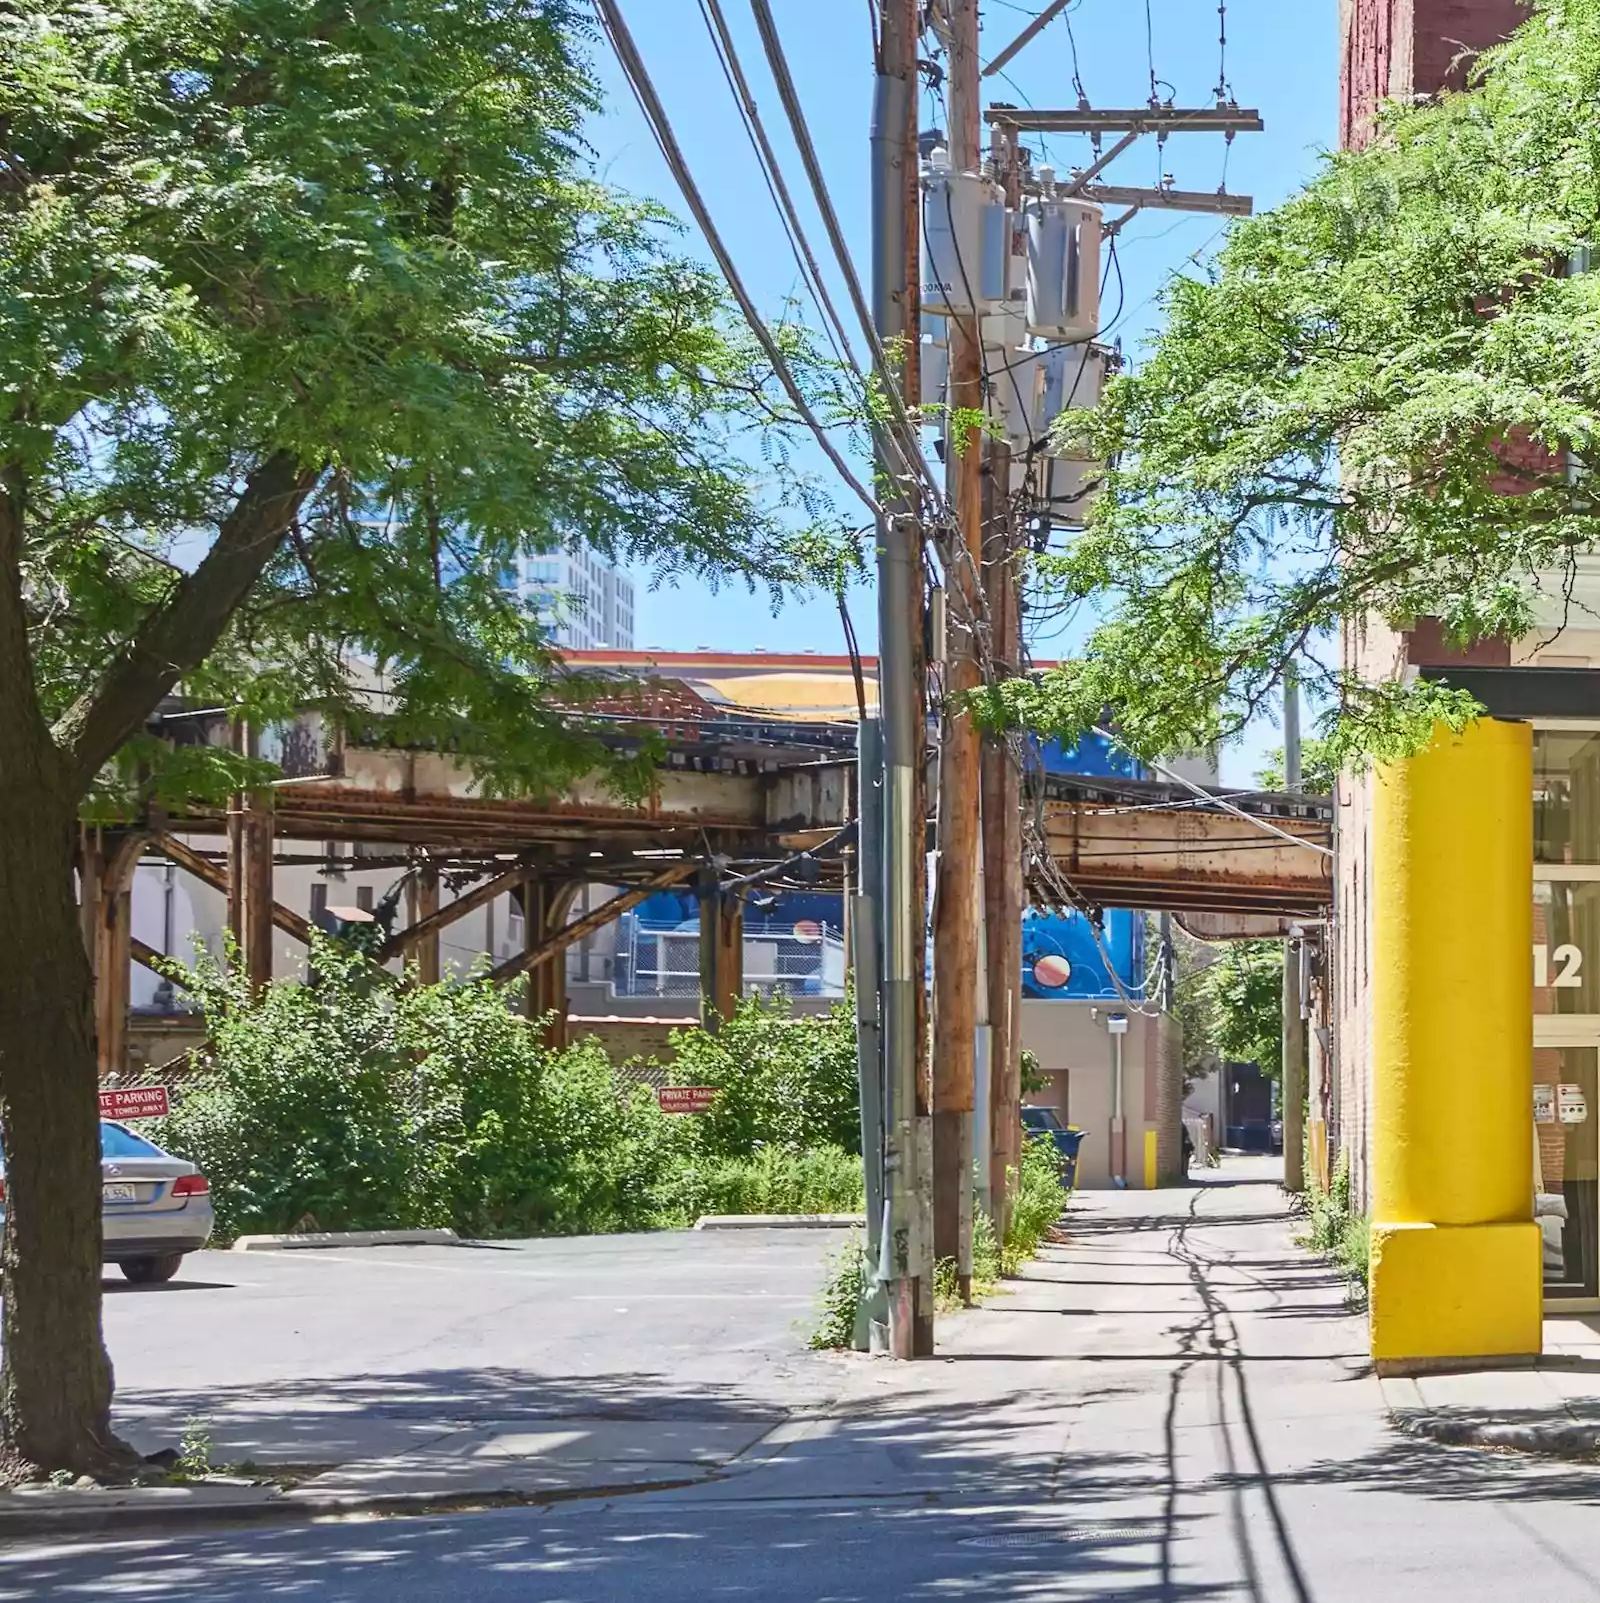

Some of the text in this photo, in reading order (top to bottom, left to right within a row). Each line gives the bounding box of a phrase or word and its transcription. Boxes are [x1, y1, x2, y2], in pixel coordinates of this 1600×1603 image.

[115, 1091, 163, 1104] PARKING
[661, 1089, 690, 1099] PRIVATE
[114, 1106, 140, 1115] TOWED
[142, 1104, 165, 1113] AWAY
